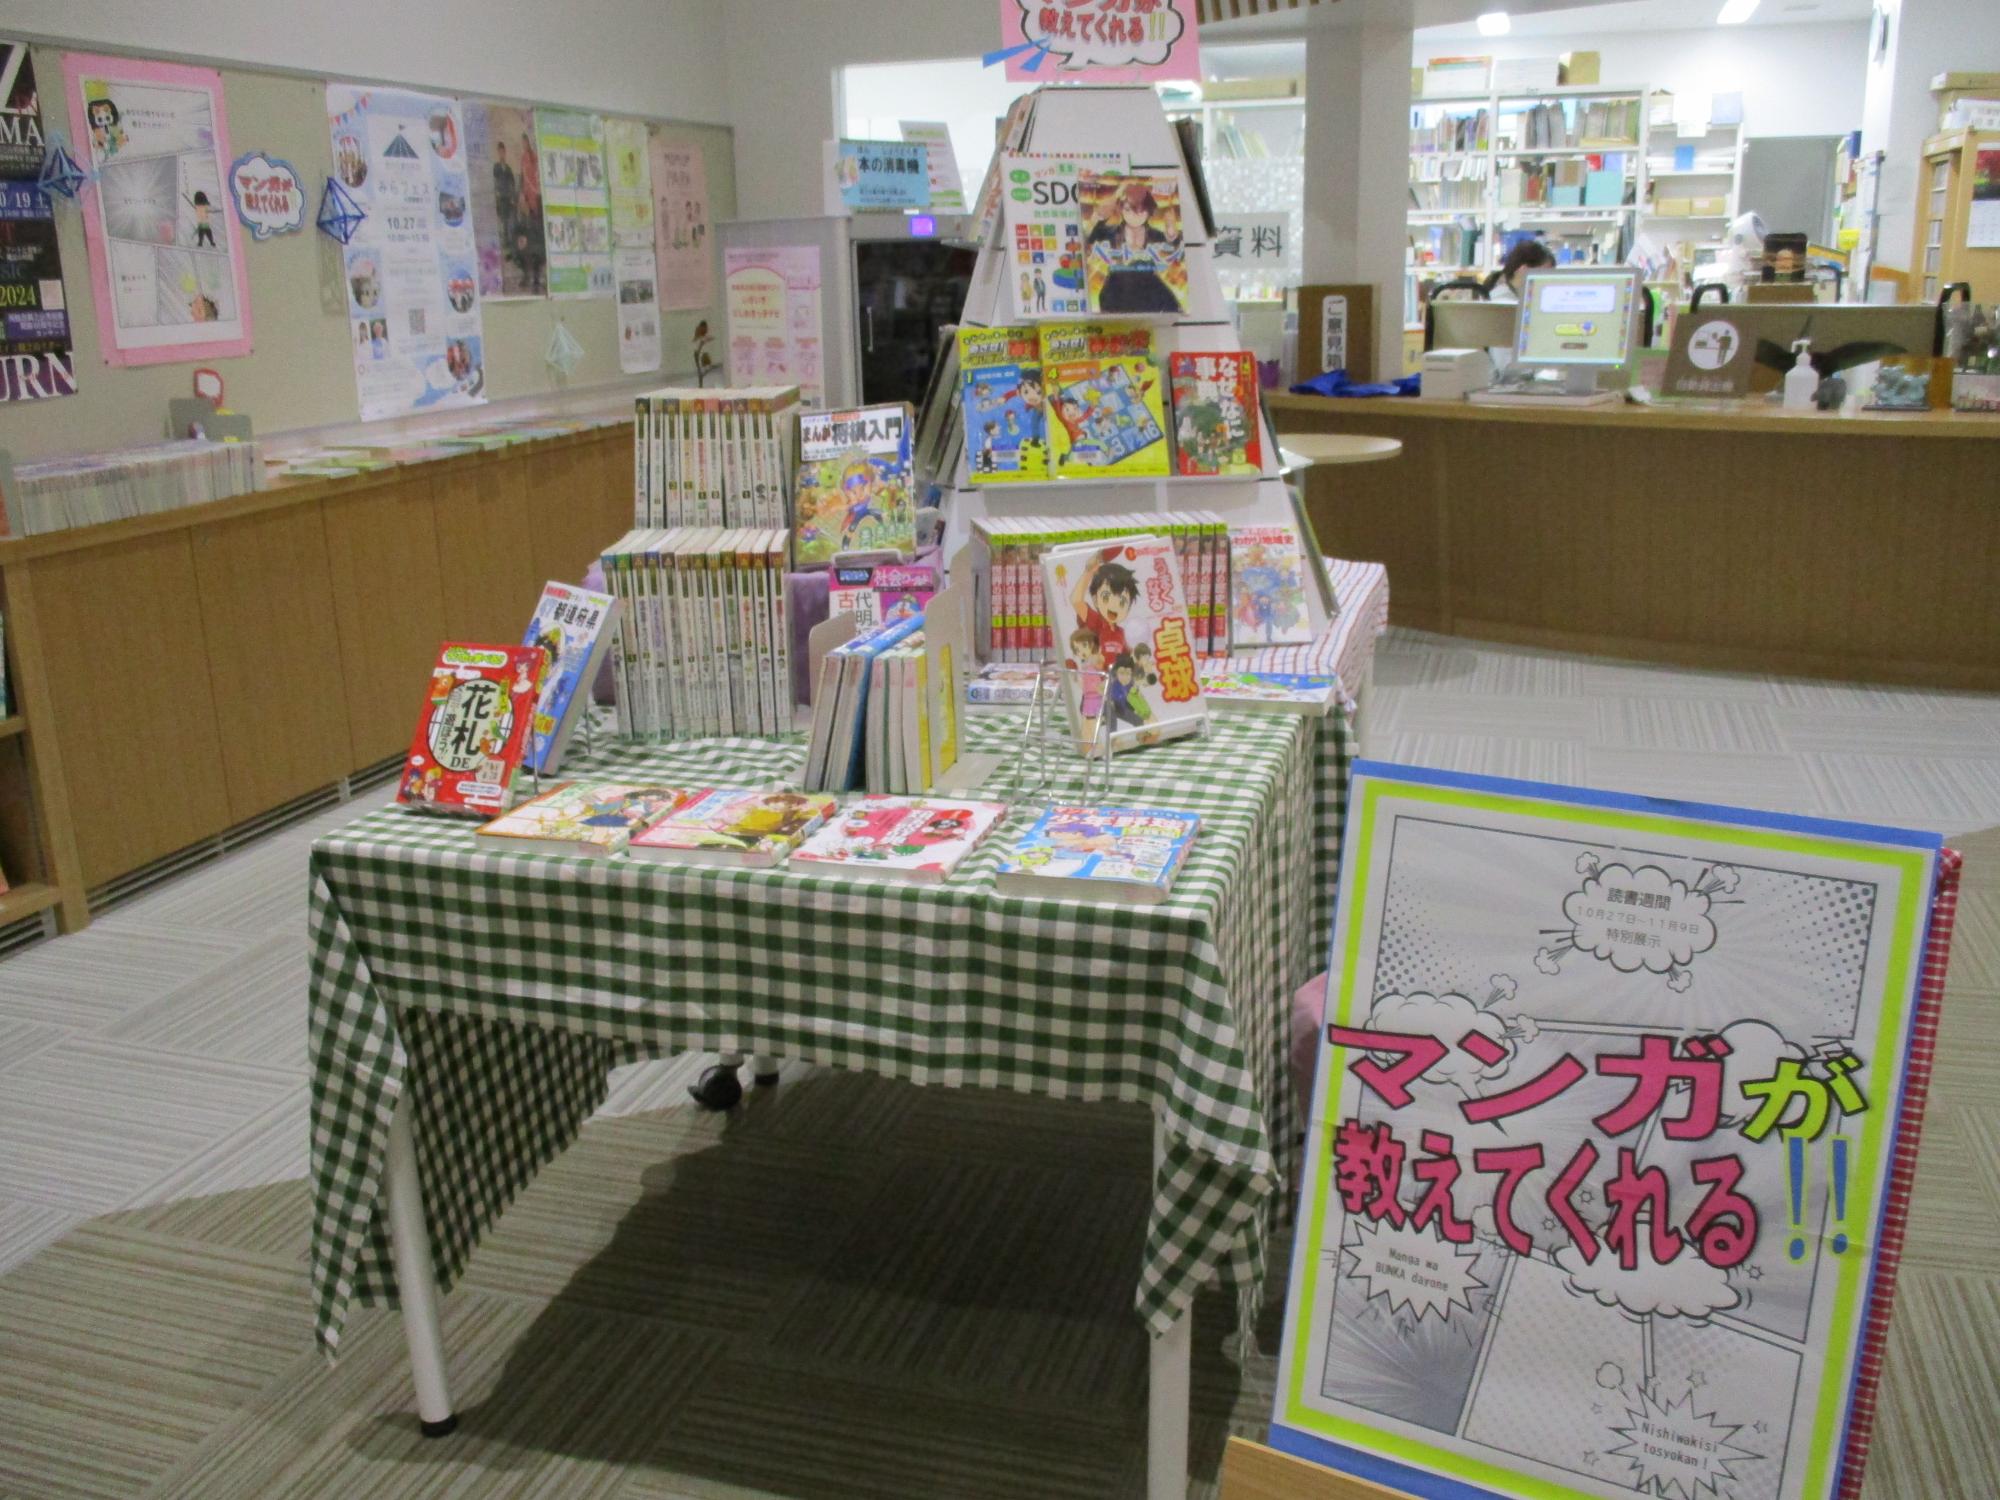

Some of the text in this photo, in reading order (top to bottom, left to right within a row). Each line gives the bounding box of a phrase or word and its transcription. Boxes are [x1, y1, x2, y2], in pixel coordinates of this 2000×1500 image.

[1153, 617, 1200, 703] 卓球
[450, 683, 498, 756] 花札
[450, 756, 471, 769] DE
[1606, 887, 1672, 911] 読書週間
[1605, 927, 1662, 949] 特別展示
[1327, 1023, 1869, 1143] マンガが
[1389, 1247, 1439, 1271] Manga wa
[1375, 1261, 1449, 1292] BUNKA dayone
[1641, 1421, 1718, 1454] Nishiwakisi
